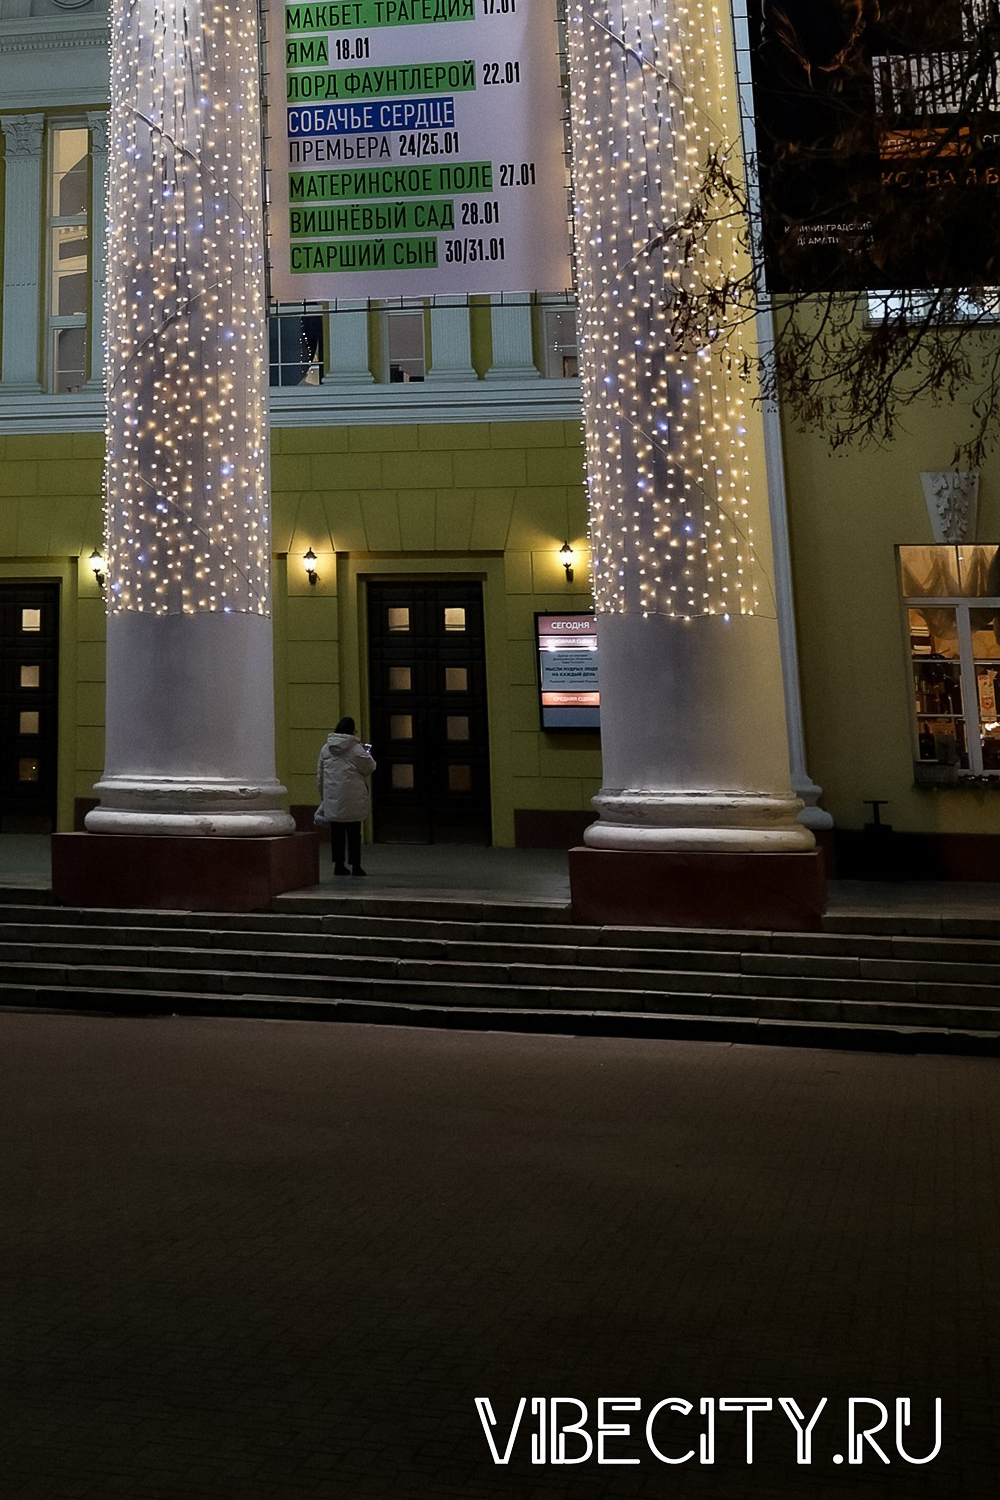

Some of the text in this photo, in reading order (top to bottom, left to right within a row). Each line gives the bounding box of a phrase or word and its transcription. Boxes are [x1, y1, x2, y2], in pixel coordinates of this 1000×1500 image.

[286, 2, 367, 29] МАКБЕТ.
[286, 37, 370, 64] ЯМА 18.01
[287, 60, 520, 98] ЛОРД ФАУНТЛЕРОЙ 22.01
[288, 101, 454, 133] СОБАЧЬЕ СЕРДЦЕ
[289, 131, 459, 162] ПРЕМЬЕРА 24/25.01
[290, 163, 535, 198] МАТЕРИНСКОЕ ПОЛЕ 27.01
[290, 202, 499, 233] ВИШНЁВЫЙ САД 28.01
[291, 238, 505, 269] СТАРШИЙ СЫН 30/31.01
